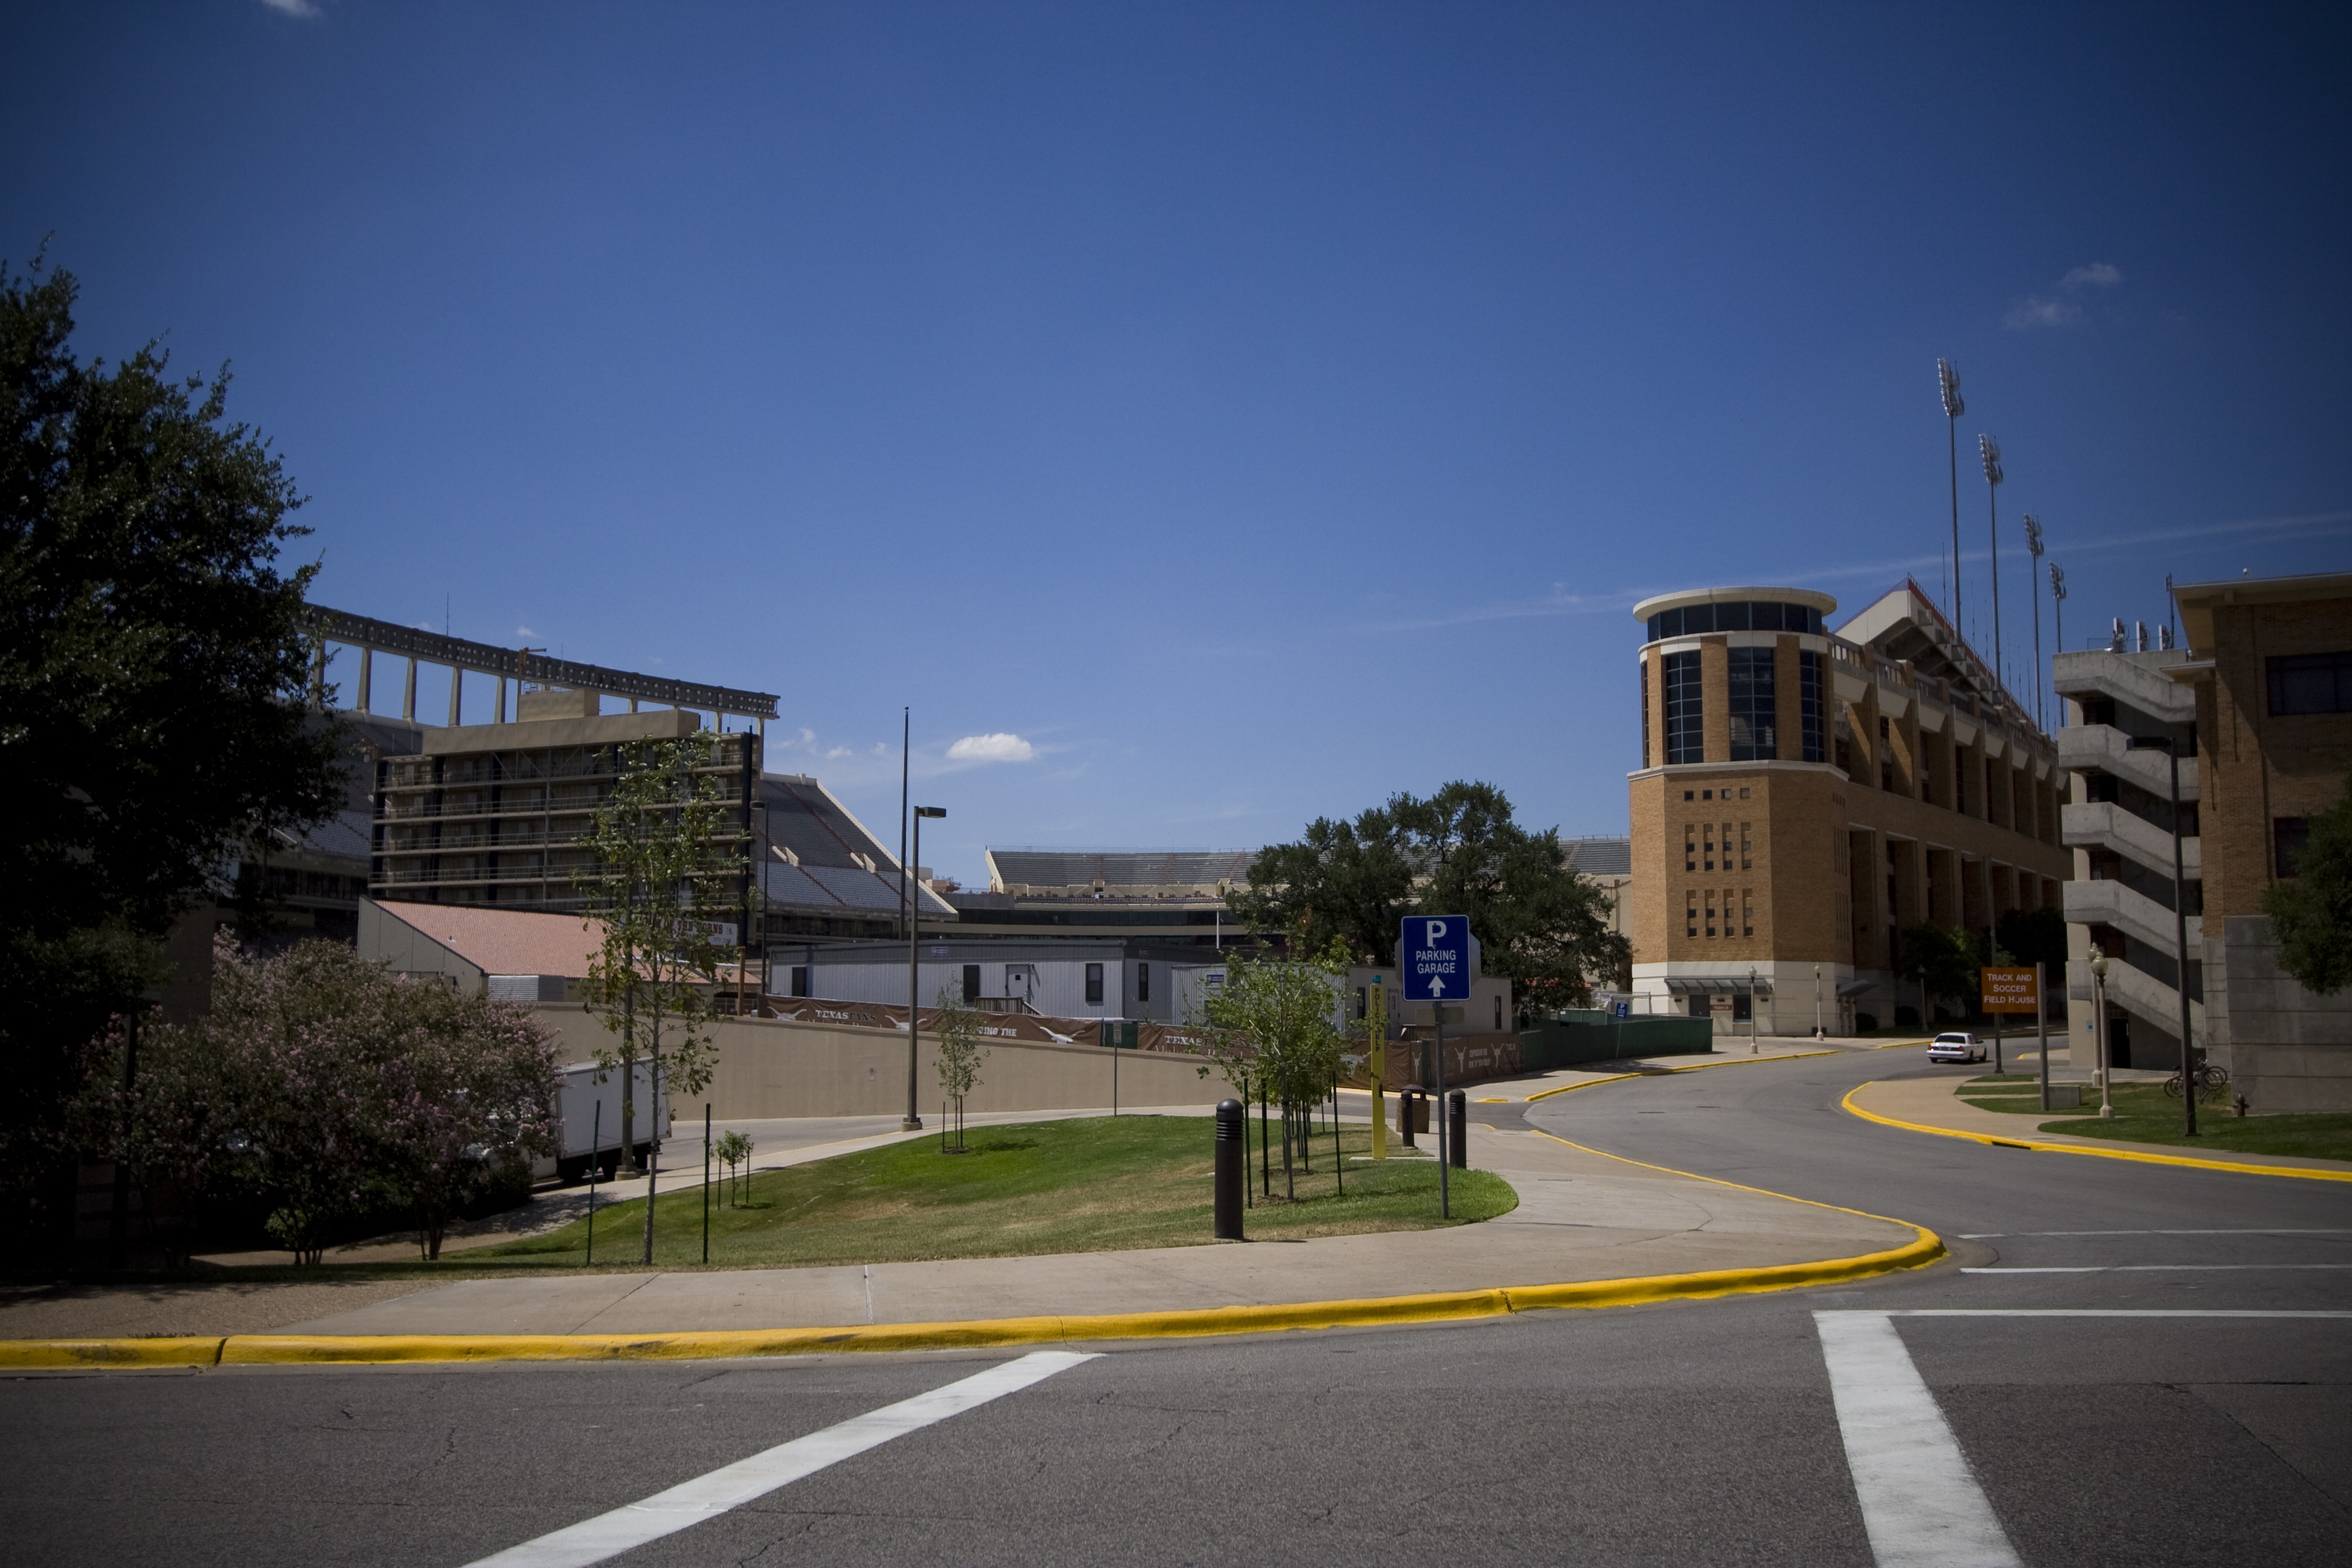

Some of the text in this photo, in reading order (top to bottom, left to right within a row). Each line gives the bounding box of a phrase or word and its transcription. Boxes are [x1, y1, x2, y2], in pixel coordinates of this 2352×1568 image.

[697, 921, 723, 934] ORNS
[1426, 920, 1447, 947] P
[1416, 950, 1456, 961] PARKING
[1417, 962, 1456, 974] GARAGE
[1987, 973, 2014, 981] TRACK
[1993, 984, 2027, 992] SOCCER
[1984, 996, 2036, 1004] FIELD HOUSE
[1000, 1028, 1017, 1036] THE
